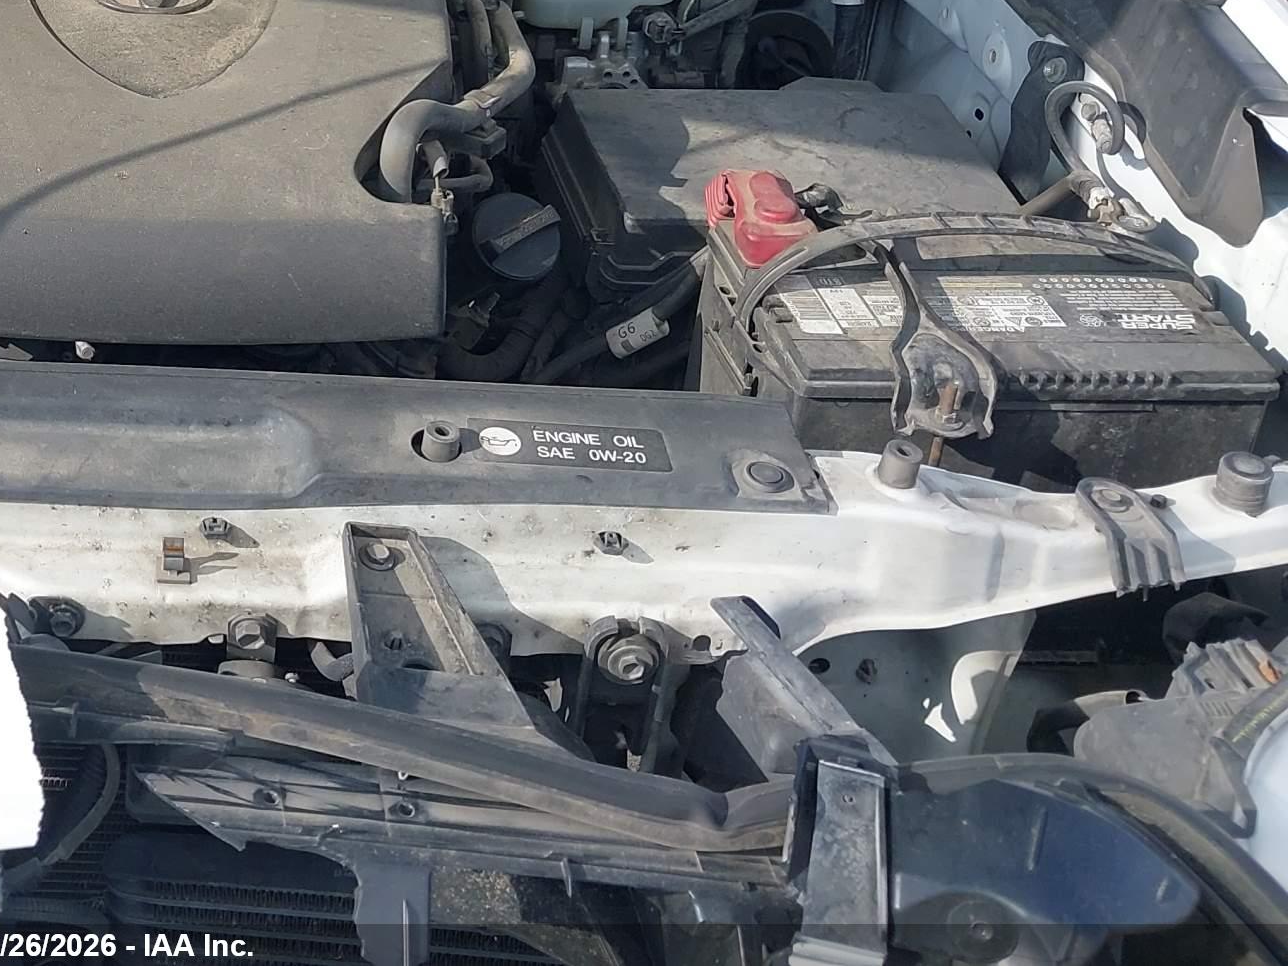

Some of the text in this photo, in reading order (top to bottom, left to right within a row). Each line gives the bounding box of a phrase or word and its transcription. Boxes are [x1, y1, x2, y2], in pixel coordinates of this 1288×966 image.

[1117, 313, 1196, 323] START
[1120, 321, 1194, 330] SUPER
[618, 321, 636, 339] G6
[532, 429, 645, 449] ENGINE OIL
[536, 445, 647, 465] SAE 0W-20
